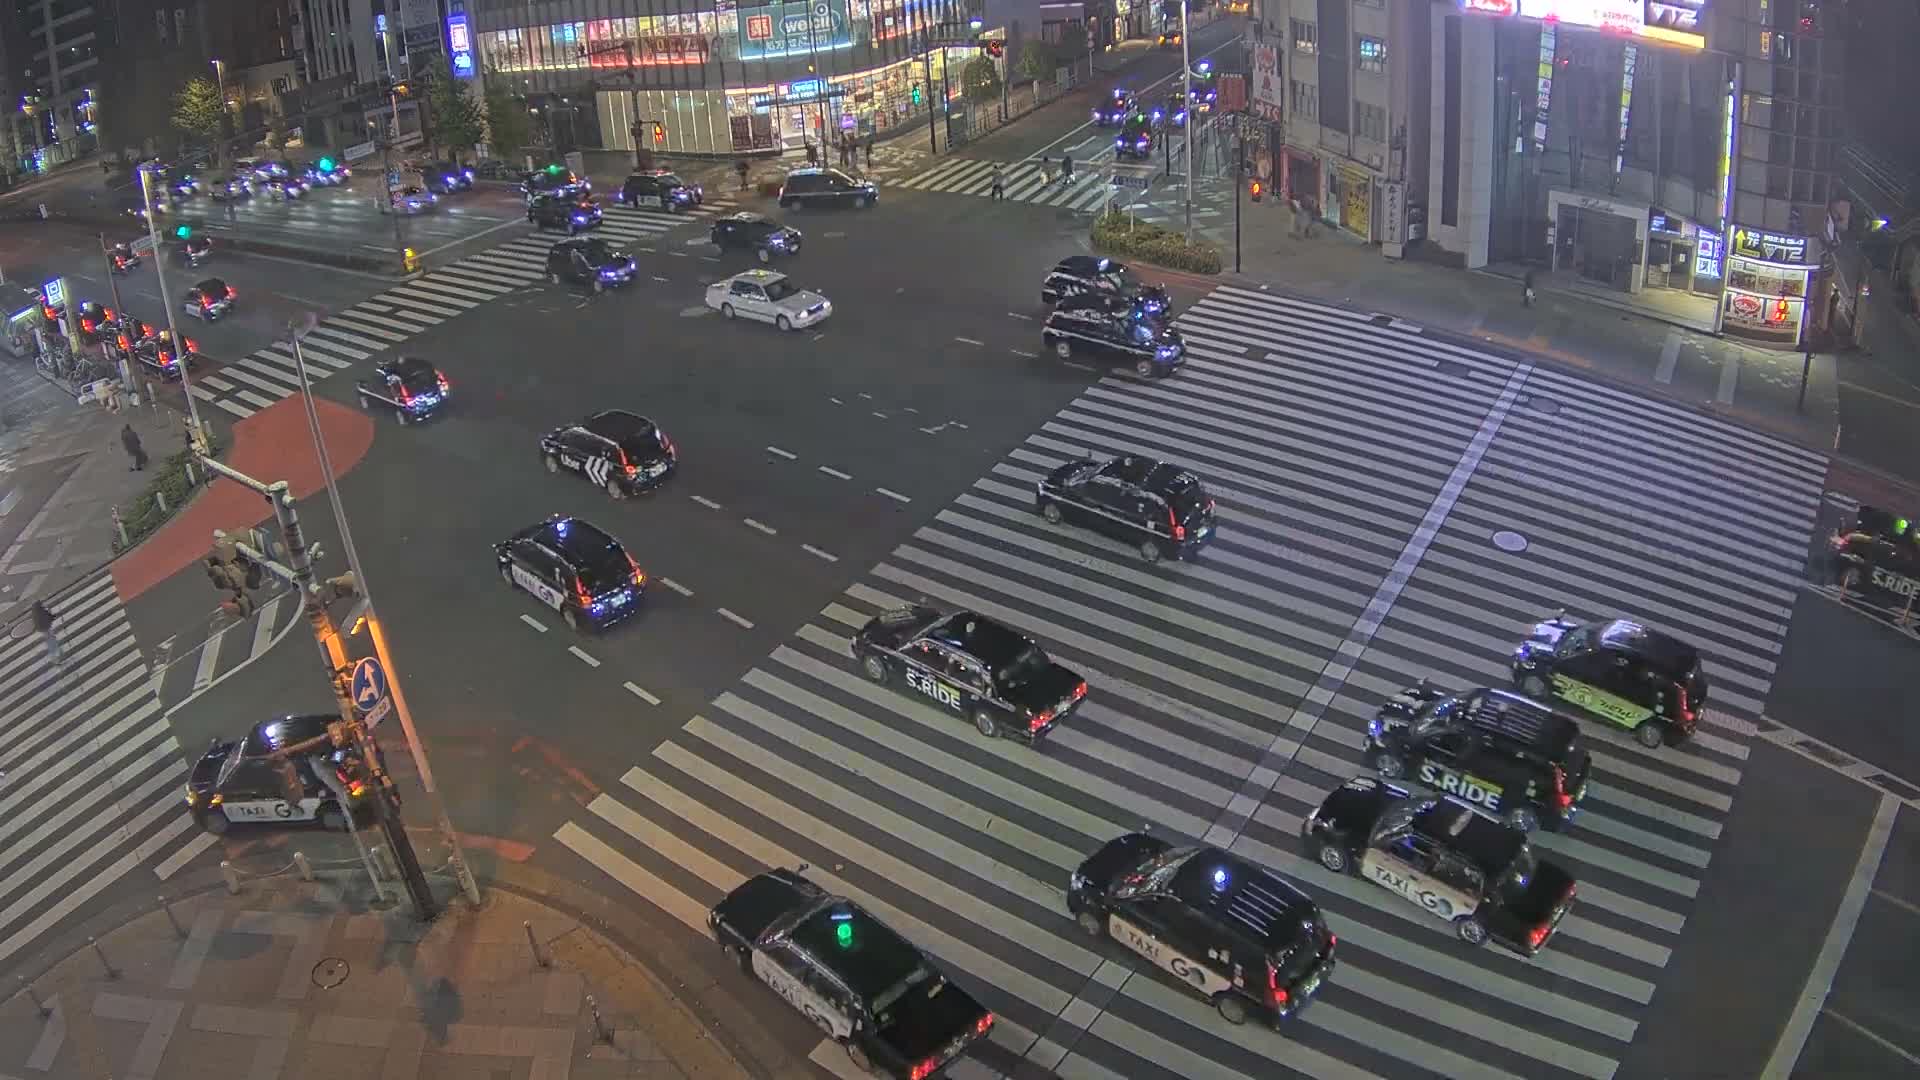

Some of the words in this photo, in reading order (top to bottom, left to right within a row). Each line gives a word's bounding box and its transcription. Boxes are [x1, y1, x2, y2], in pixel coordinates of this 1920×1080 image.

[906, 672, 961, 712] S.RIDE
[1419, 764, 1502, 811] S.RIDE
[1375, 865, 1409, 893] TAXI
[1128, 930, 1160, 958] TAXI
